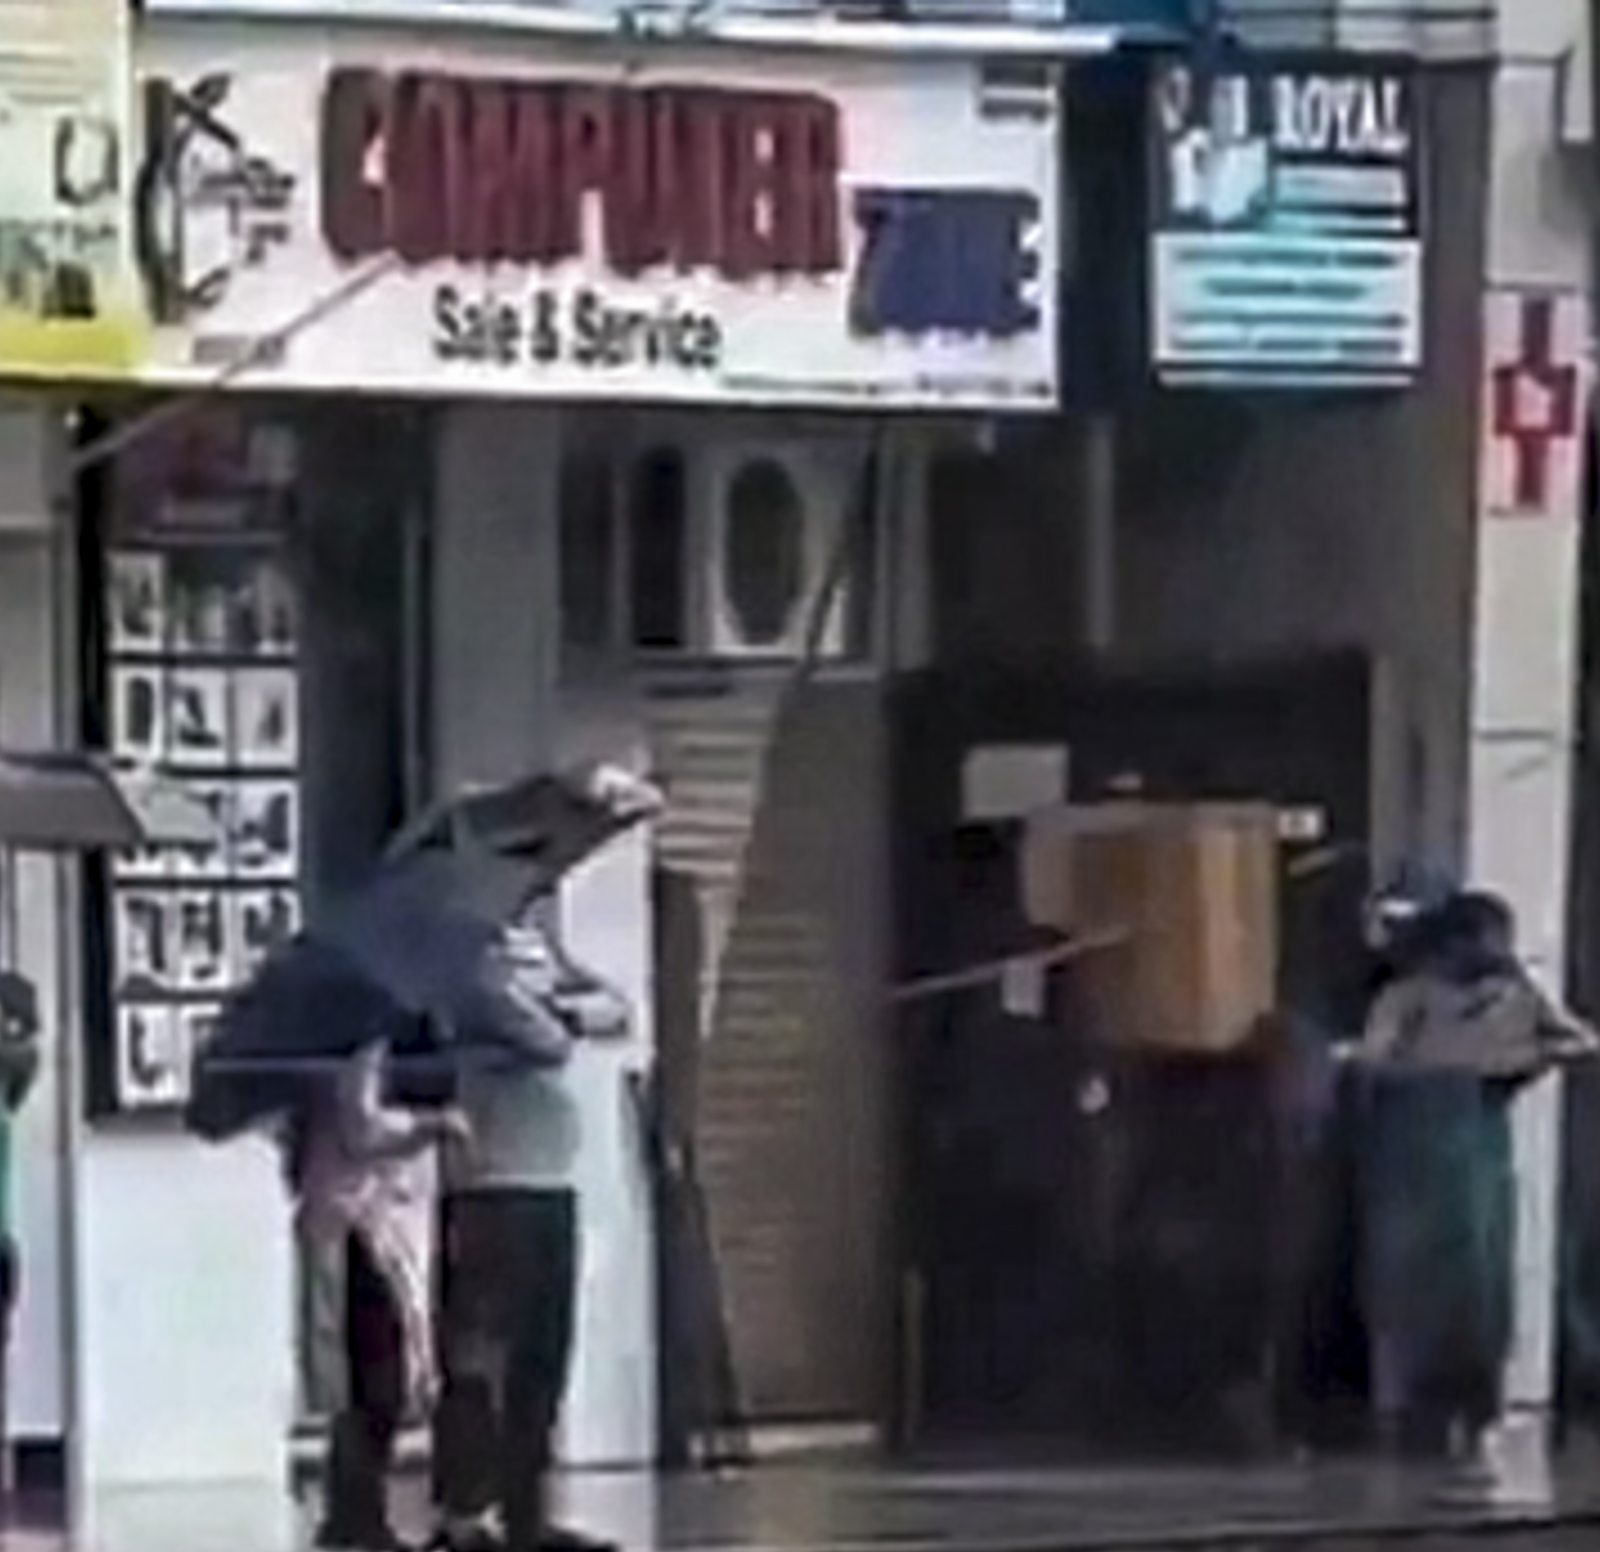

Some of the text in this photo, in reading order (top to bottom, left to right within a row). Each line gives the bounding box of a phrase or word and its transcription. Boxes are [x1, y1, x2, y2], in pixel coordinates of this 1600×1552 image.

[1272, 73, 1410, 152] ROYAL
[432, 284, 722, 368] Sale & Service
